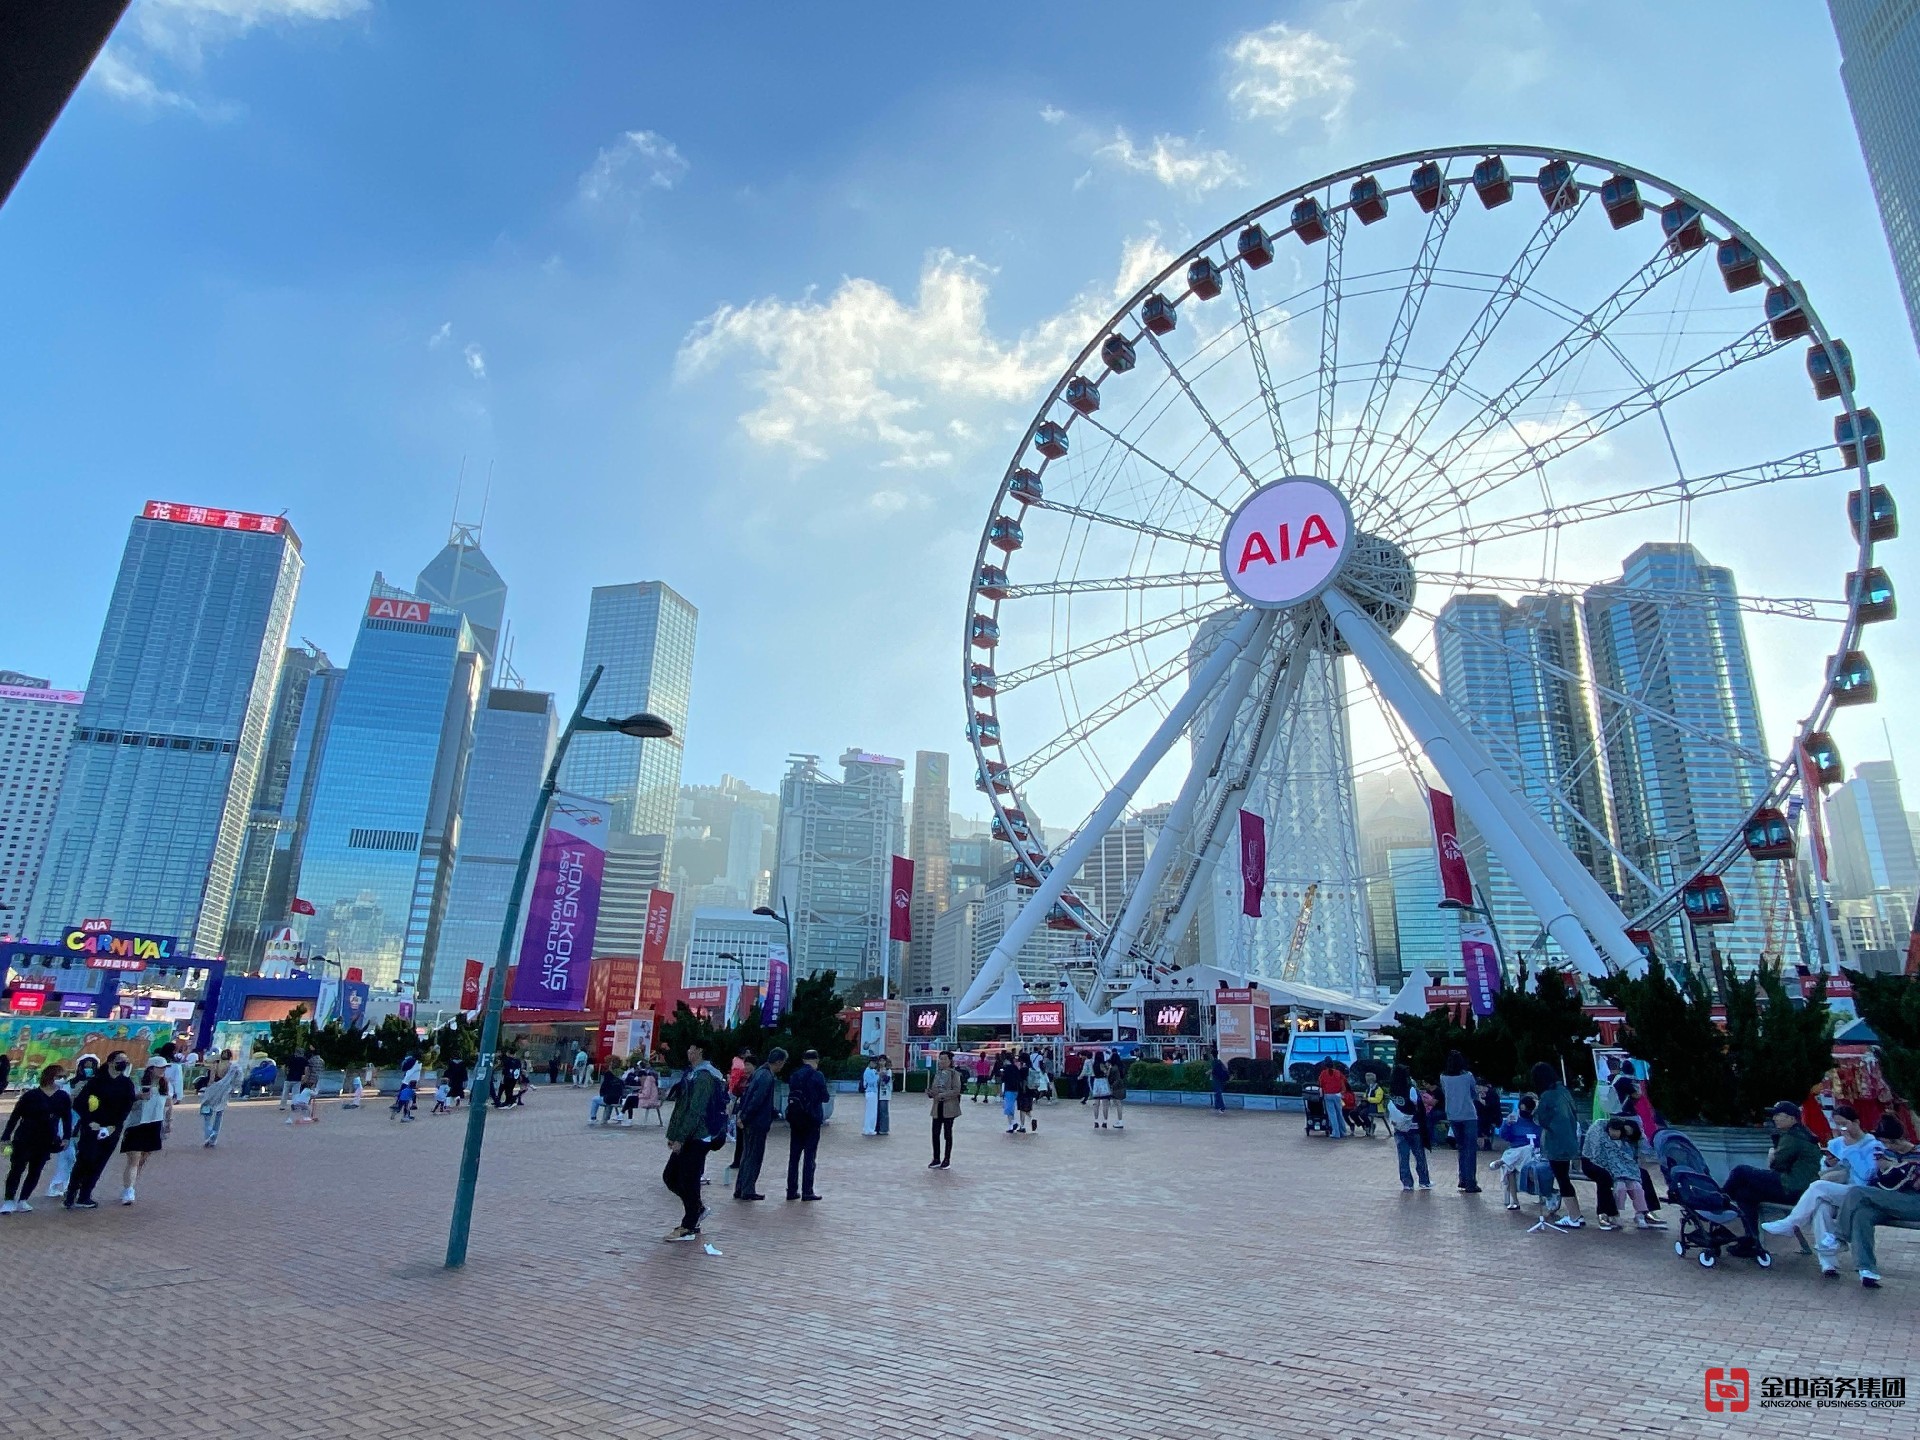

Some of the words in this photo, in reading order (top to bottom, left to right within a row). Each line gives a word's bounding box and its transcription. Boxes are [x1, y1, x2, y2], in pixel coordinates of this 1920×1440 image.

[1237, 513, 1338, 574] AIA
[375, 600, 421, 620] AIA
[22, 692, 59, 700] AMERICA
[555, 849, 571, 896] ASIA'S
[563, 850, 585, 918] HONG
[84, 921, 108, 931] AIA
[547, 899, 562, 950] WORLD
[648, 909, 659, 935] PARK
[658, 905, 667, 924] AIA
[66, 931, 170, 959] CARNIVAL
[551, 921, 575, 991] KONG
[540, 952, 554, 990] CITY
[610, 987, 627, 996] PLAY
[917, 1011, 938, 1026] HW
[1022, 1014, 1059, 1023] ENTRANCE
[1157, 1007, 1185, 1024] HW
